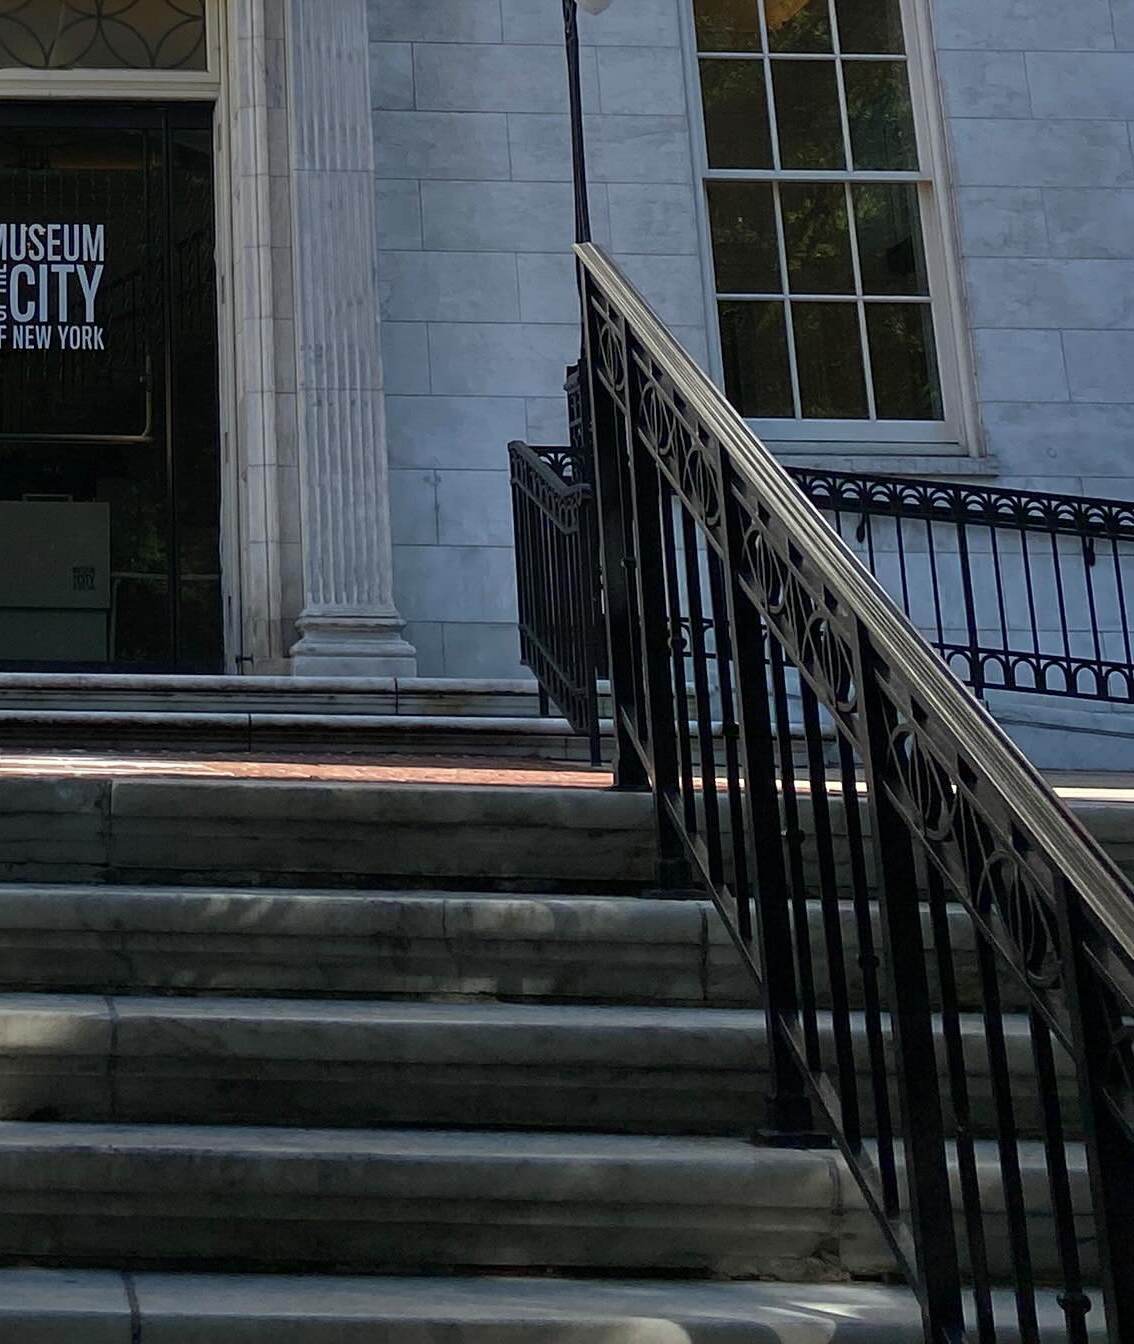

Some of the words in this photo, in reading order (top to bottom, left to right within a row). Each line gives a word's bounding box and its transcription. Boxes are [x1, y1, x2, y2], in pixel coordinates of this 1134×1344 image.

[9, 263, 105, 323] CITY
[12, 325, 52, 350] NEW
[57, 325, 105, 350] YORK
